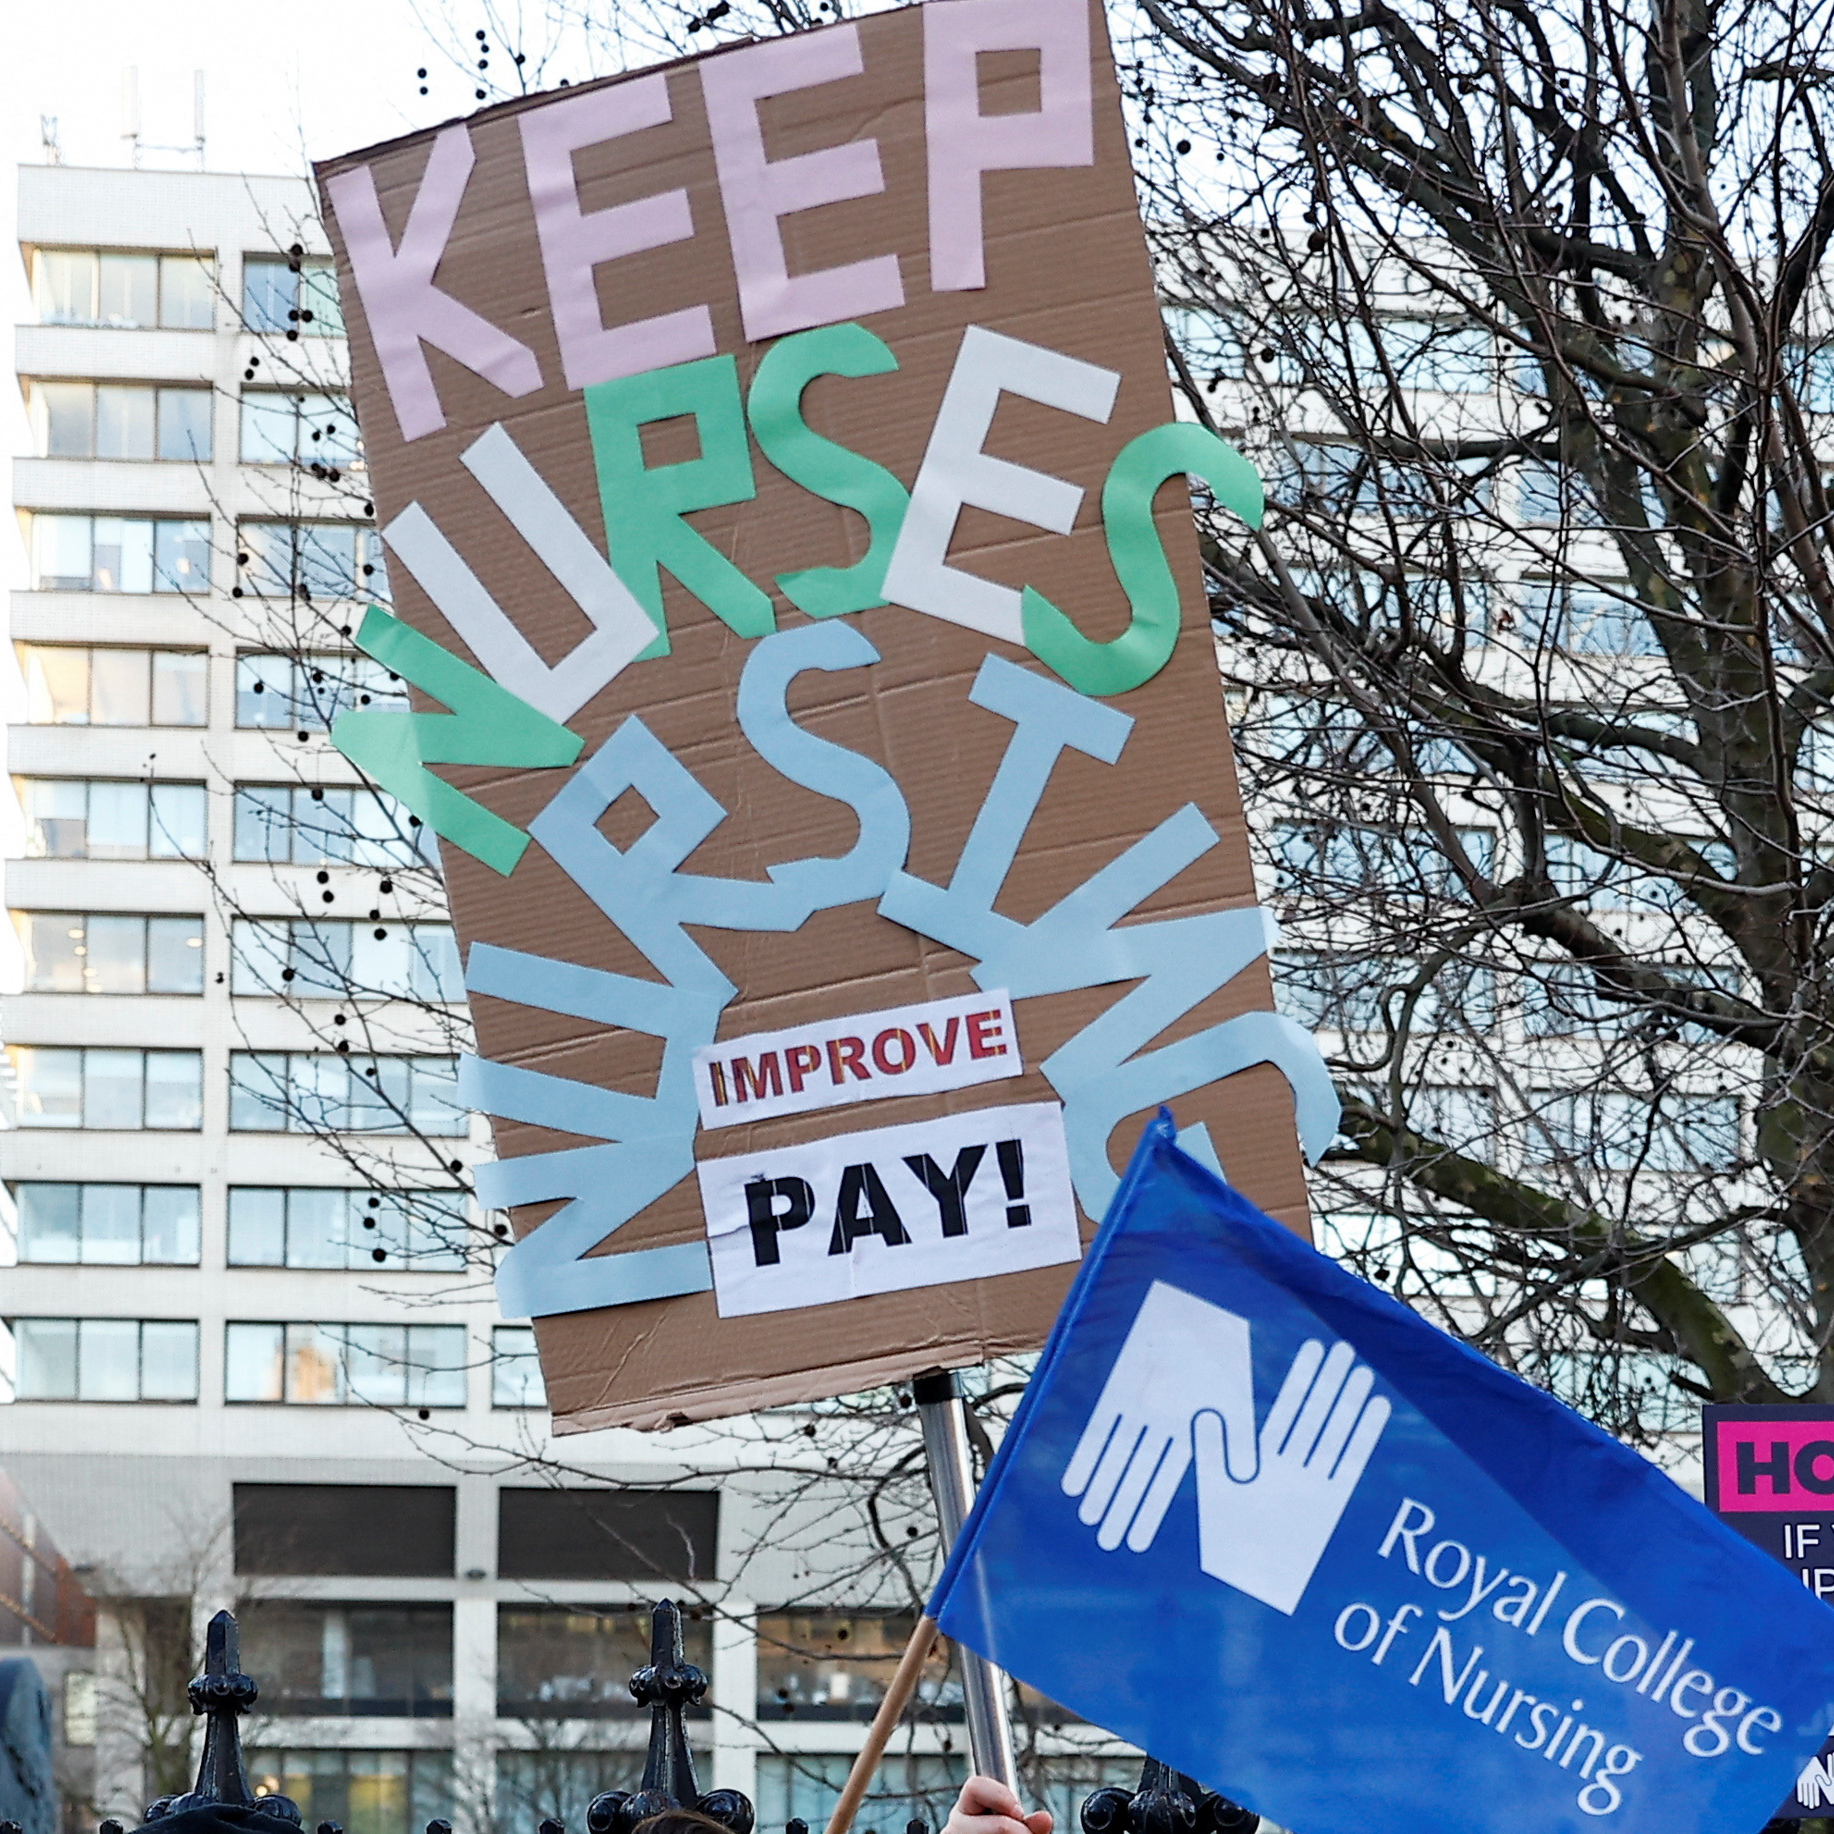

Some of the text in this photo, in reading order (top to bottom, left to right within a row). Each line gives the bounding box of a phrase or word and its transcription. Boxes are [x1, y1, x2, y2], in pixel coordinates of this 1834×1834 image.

[325, 0, 1094, 442] KEEP
[331, 323, 1264, 877] NURSES
[457, 618, 1340, 1318] NURSING
[708, 1008, 1009, 1107] IMPROVE
[742, 1138, 1030, 1267] PAY!
[1376, 1494, 1783, 1758] Royal College
[1784, 1523, 1821, 1559] IF
[1332, 1599, 1644, 1818] of Nursing
